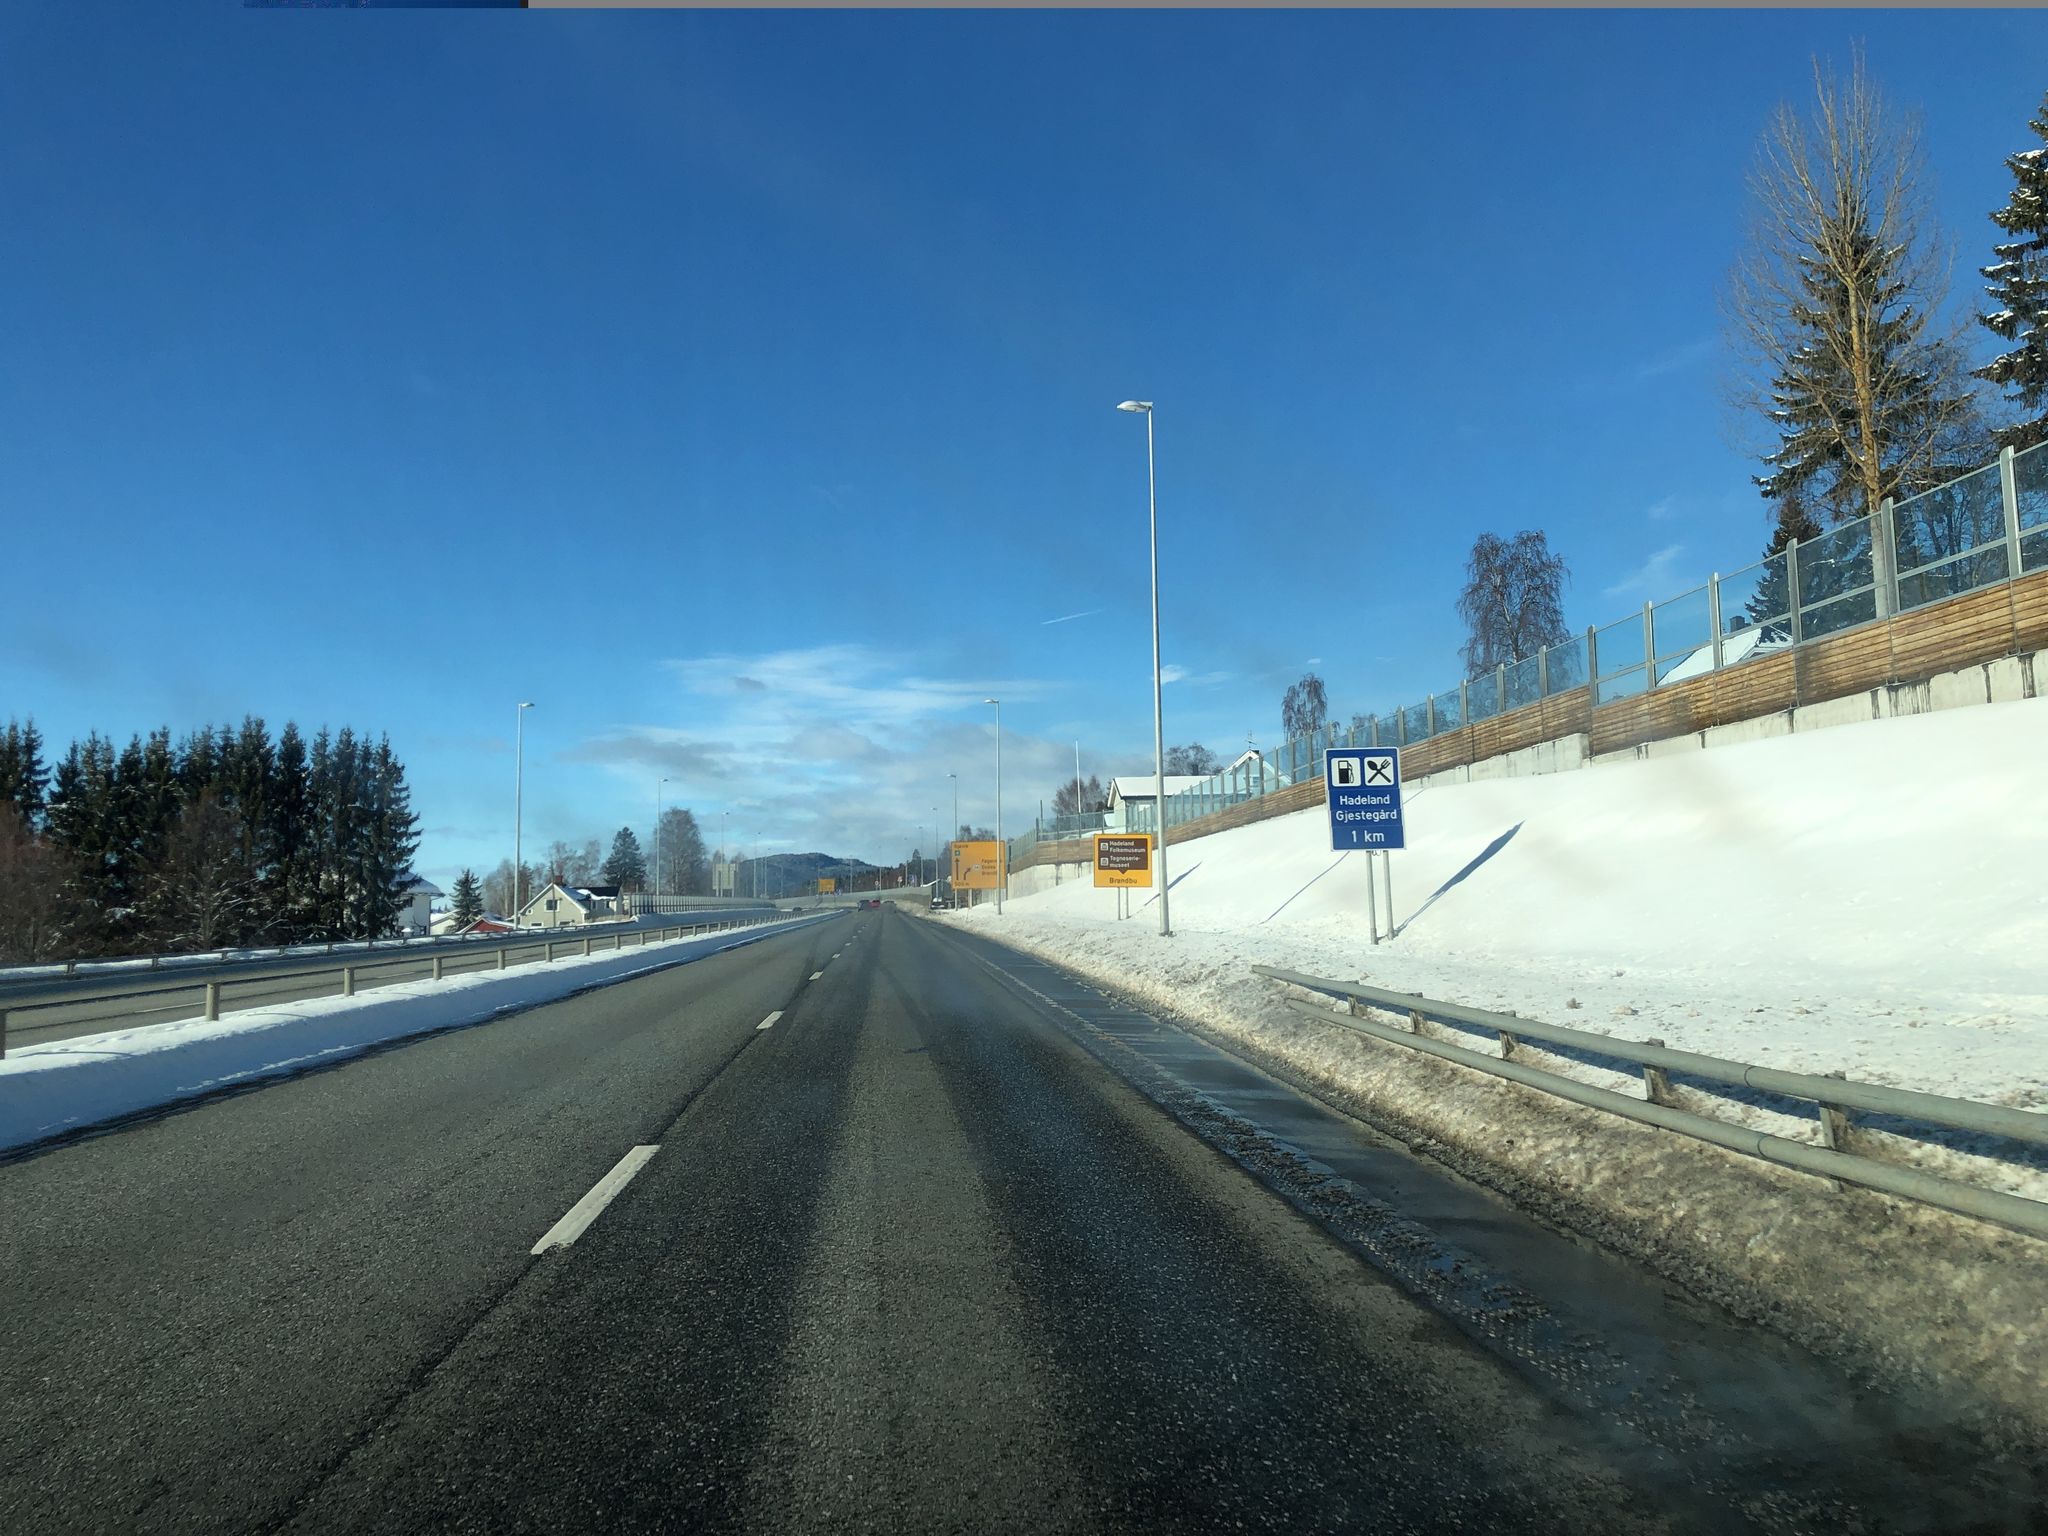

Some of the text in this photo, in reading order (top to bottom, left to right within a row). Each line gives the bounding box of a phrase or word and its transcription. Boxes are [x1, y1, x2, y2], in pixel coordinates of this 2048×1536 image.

[1339, 794, 1390, 805] Hadeland
[1336, 810, 1397, 823] Gjestegård
[1351, 830, 1385, 843] 1 km
